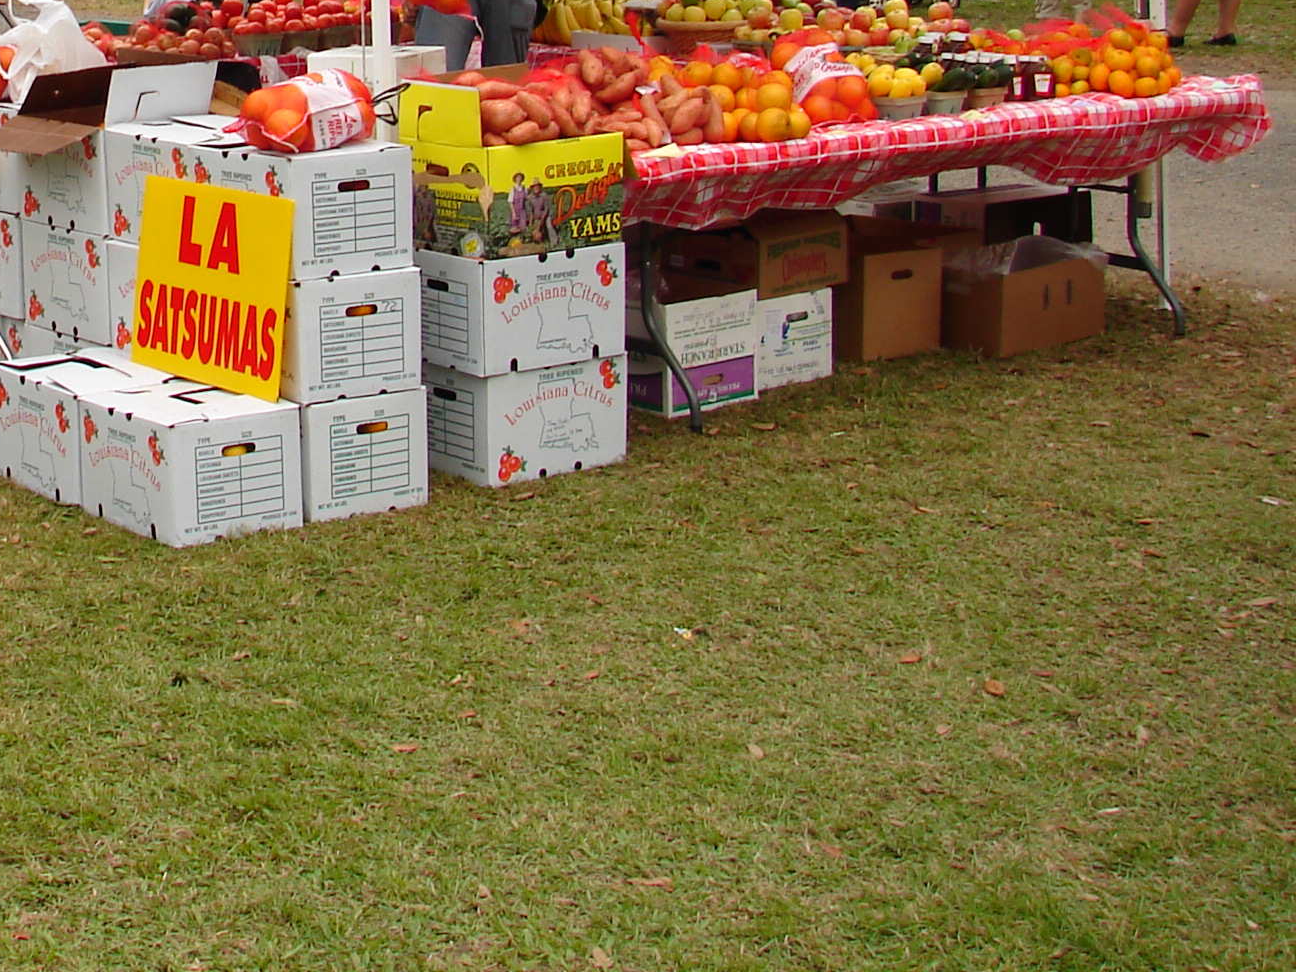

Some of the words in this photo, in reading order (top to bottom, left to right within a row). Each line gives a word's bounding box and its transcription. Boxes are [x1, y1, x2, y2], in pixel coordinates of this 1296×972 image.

[332, 113, 342, 137] TREE
[115, 159, 153, 186] Louisiana
[314, 172, 327, 180] TYPE
[545, 158, 604, 179] CREOLE
[552, 162, 624, 225] Delight
[178, 195, 240, 275] LA
[570, 212, 621, 239] YAMS
[30, 250, 67, 272] Louisiana
[69, 250, 97, 286] Citrus
[536, 273, 552, 282] TREE
[553, 269, 579, 279] RIPENED
[322, 296, 335, 304] TYPE
[381, 300, 397, 312] 72
[501, 284, 567, 325] Louisiana
[571, 282, 611, 311] Citrus
[137, 279, 277, 381] SATSUMAS
[681, 349, 714, 364] RANCH
[538, 373, 555, 382] TREE
[556, 367, 584, 378] RIPENED
[504, 385, 569, 426] Louisiana
[573, 380, 615, 408] Citrus
[332, 415, 346, 423] TYPE
[0, 409, 38, 432] Louisiana
[40, 417, 67, 458] Citrus
[197, 437, 211, 445] TYPE
[88, 442, 129, 467] Louisiana
[131, 450, 162, 492] Citrus
